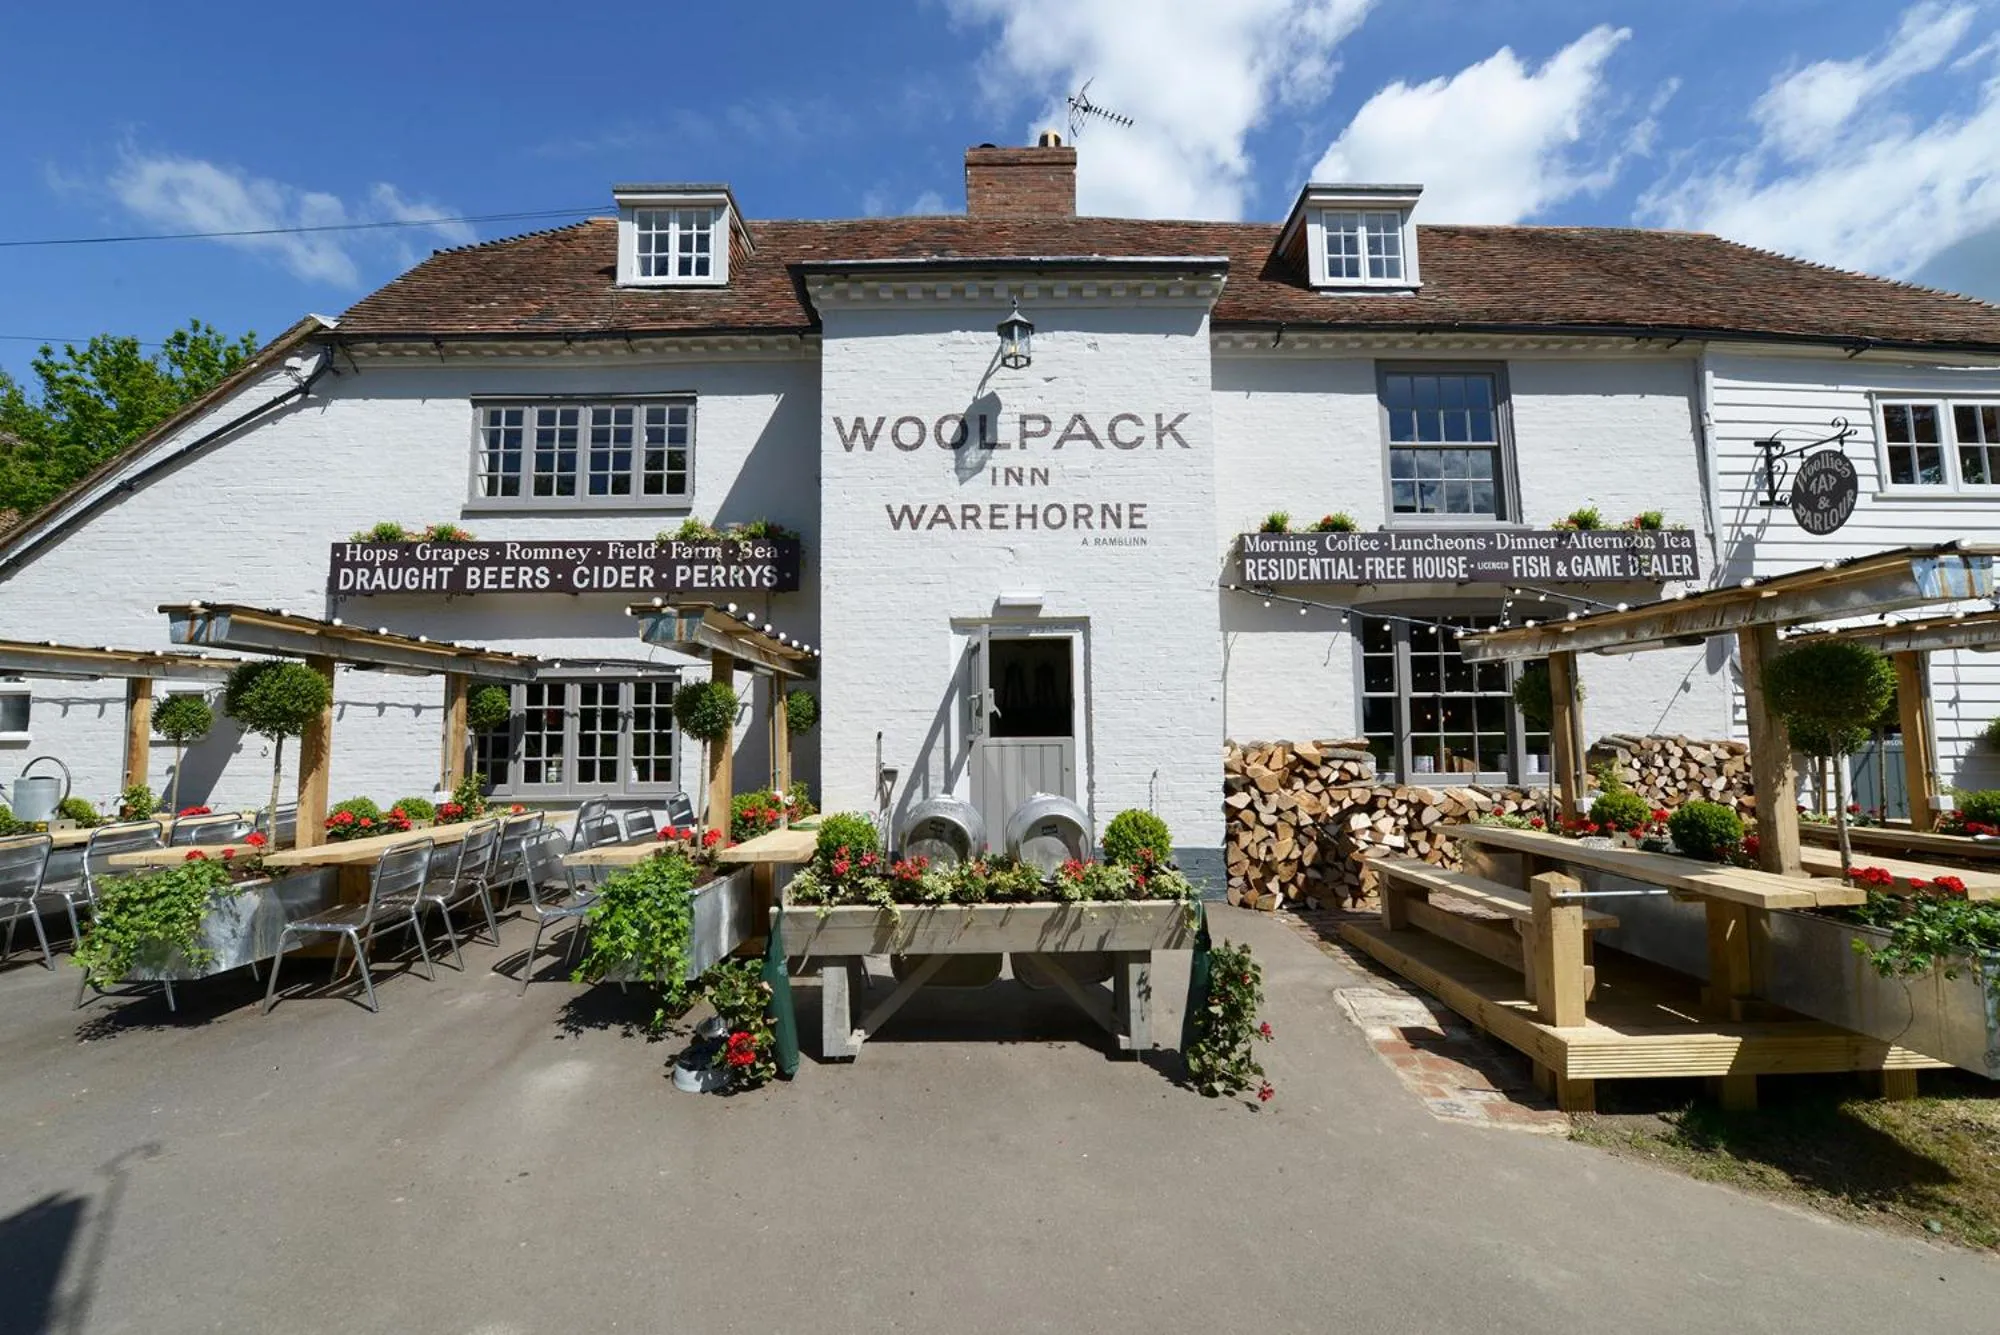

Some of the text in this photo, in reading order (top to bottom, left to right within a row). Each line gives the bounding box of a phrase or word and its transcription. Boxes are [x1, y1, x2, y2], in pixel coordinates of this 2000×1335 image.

[832, 412, 1192, 452] WOOLPACK
[991, 467, 1050, 486] INN
[1796, 452, 1851, 493] Woollies
[1810, 473, 1837, 495] TAP
[1796, 489, 1855, 531] PARLOUR
[1817, 496, 1831, 510] &
[885, 503, 1148, 530] WAREHORNE
[344, 541, 778, 566] Hops Grapes Romney Field Farm Sea
[1081, 537, 1089, 546] A
[1243, 531, 1692, 556] Morning Coffee Luncheons Dinner Afternoon Tea
[338, 565, 778, 590] DRAUGHT BEERS CIDER PERRYS
[1245, 557, 1359, 581] RESIDENTIAL
[1365, 557, 1406, 580] FREE
[1413, 556, 1469, 579] HOUSE
[1512, 556, 1551, 577] FISH
[1556, 559, 1568, 577] &
[1571, 555, 1623, 577] GAME
[1628, 554, 1694, 576] DEALER
